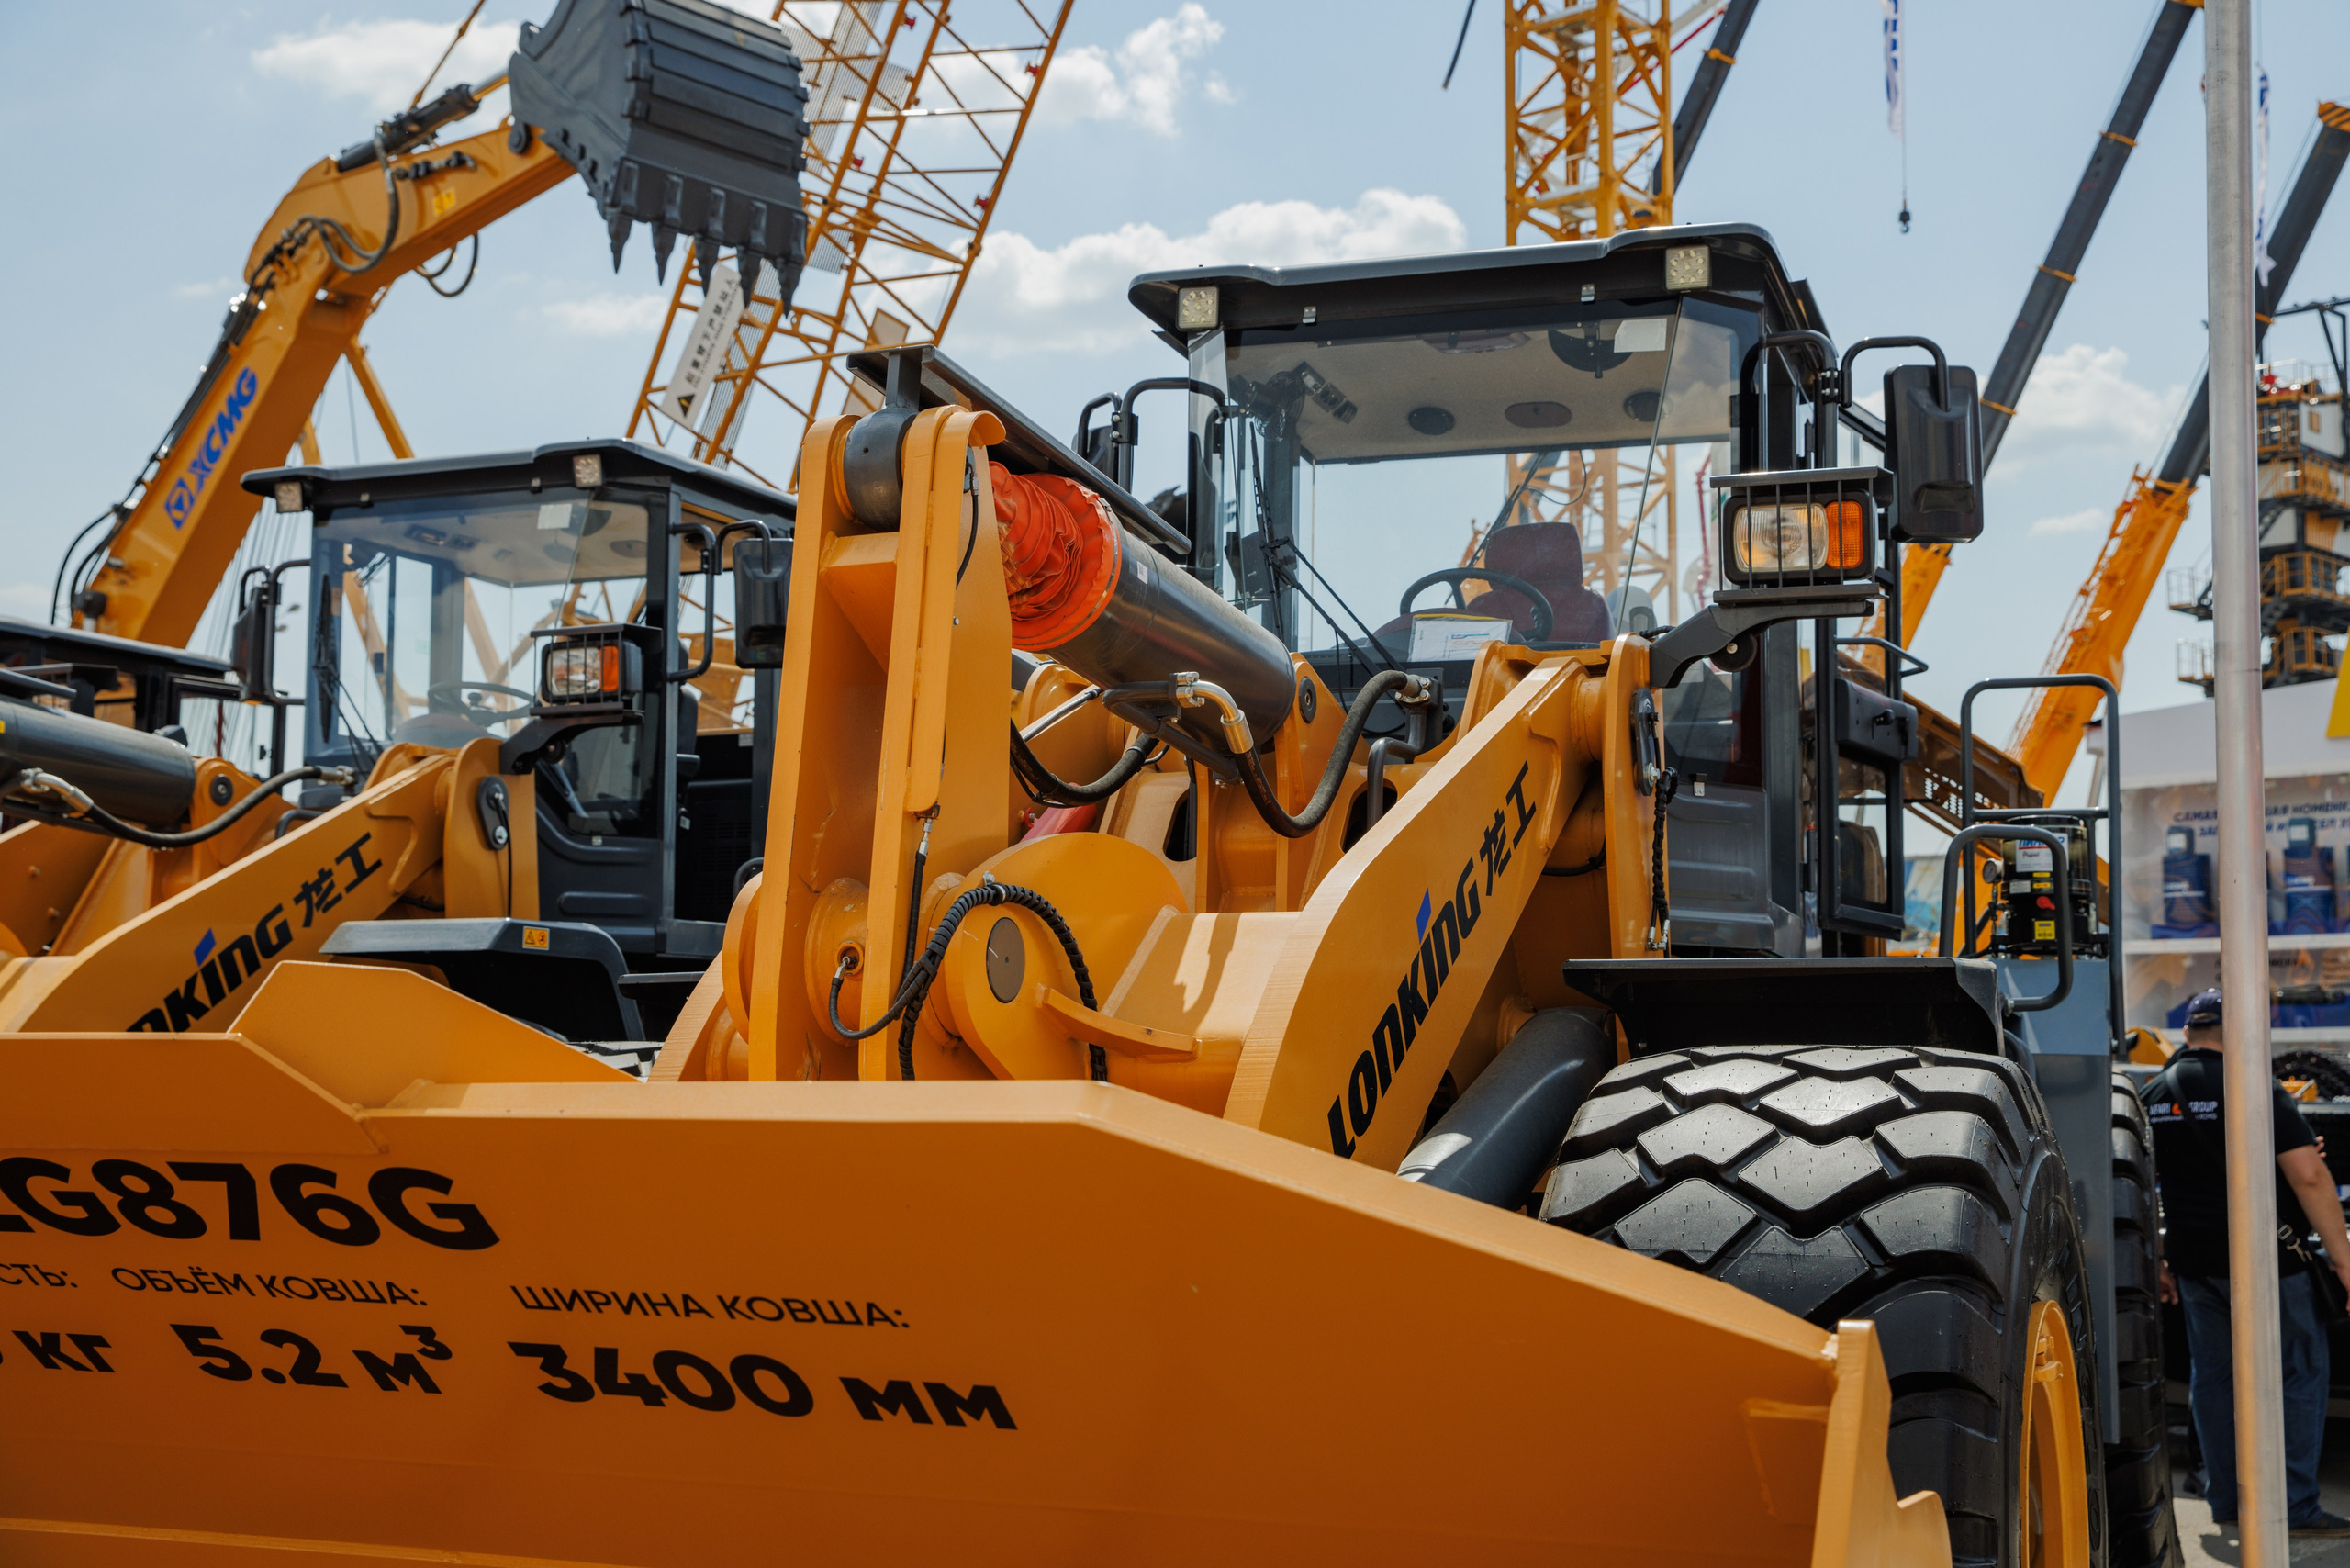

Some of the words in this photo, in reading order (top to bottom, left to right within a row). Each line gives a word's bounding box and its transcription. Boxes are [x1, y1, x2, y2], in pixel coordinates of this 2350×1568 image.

[188, 367, 258, 498] XCMG
[293, 831, 383, 928] 龙工
[1327, 856, 1482, 1159] LONKING
[1479, 759, 1538, 897] 龙工
[111, 1266, 256, 1297] ОБЪЁМ
[255, 1275, 428, 1306] КОВША:
[510, 1285, 715, 1319] ШИРИНА
[716, 1295, 911, 1328] КОВША:
[169, 1323, 350, 1389] 5.2
[507, 1341, 815, 1418] 3400
